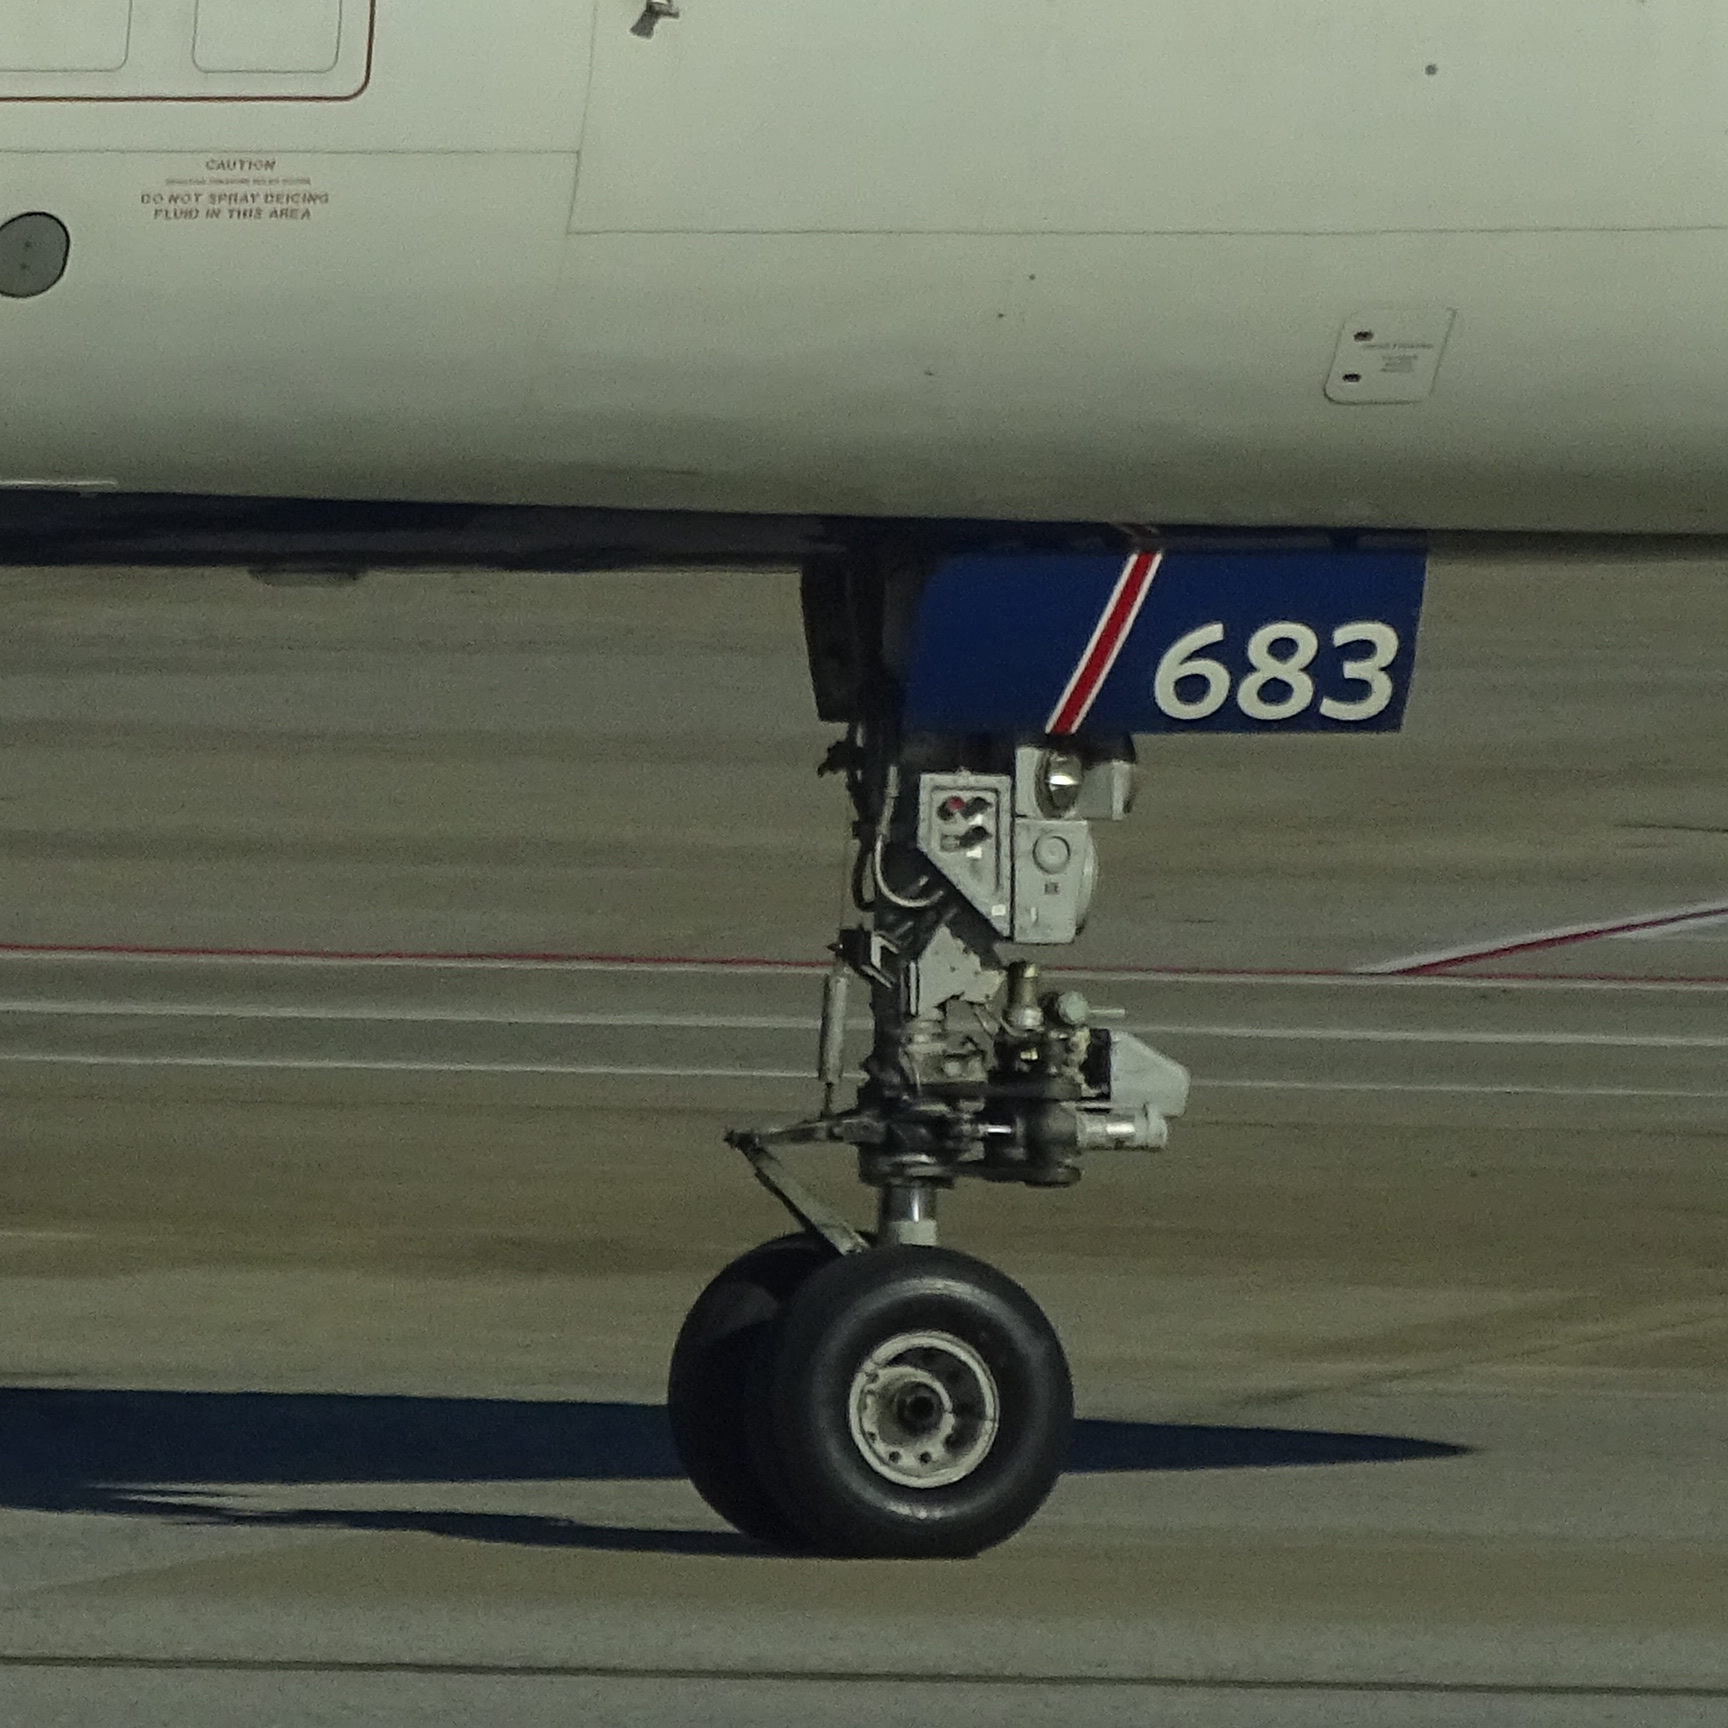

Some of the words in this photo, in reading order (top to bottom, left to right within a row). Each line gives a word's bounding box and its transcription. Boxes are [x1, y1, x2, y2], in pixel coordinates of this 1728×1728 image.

[205, 158, 277, 171] CAUTION
[140, 193, 164, 205] DO
[168, 193, 203, 205] NOT
[209, 193, 260, 205] SPRAY
[264, 193, 329, 205] DEICING
[153, 208, 200, 220] FLUID
[205, 208, 222, 220] IN
[228, 208, 264, 220] THIS
[269, 208, 312, 220] AREA
[1153, 620, 1399, 721] 683
